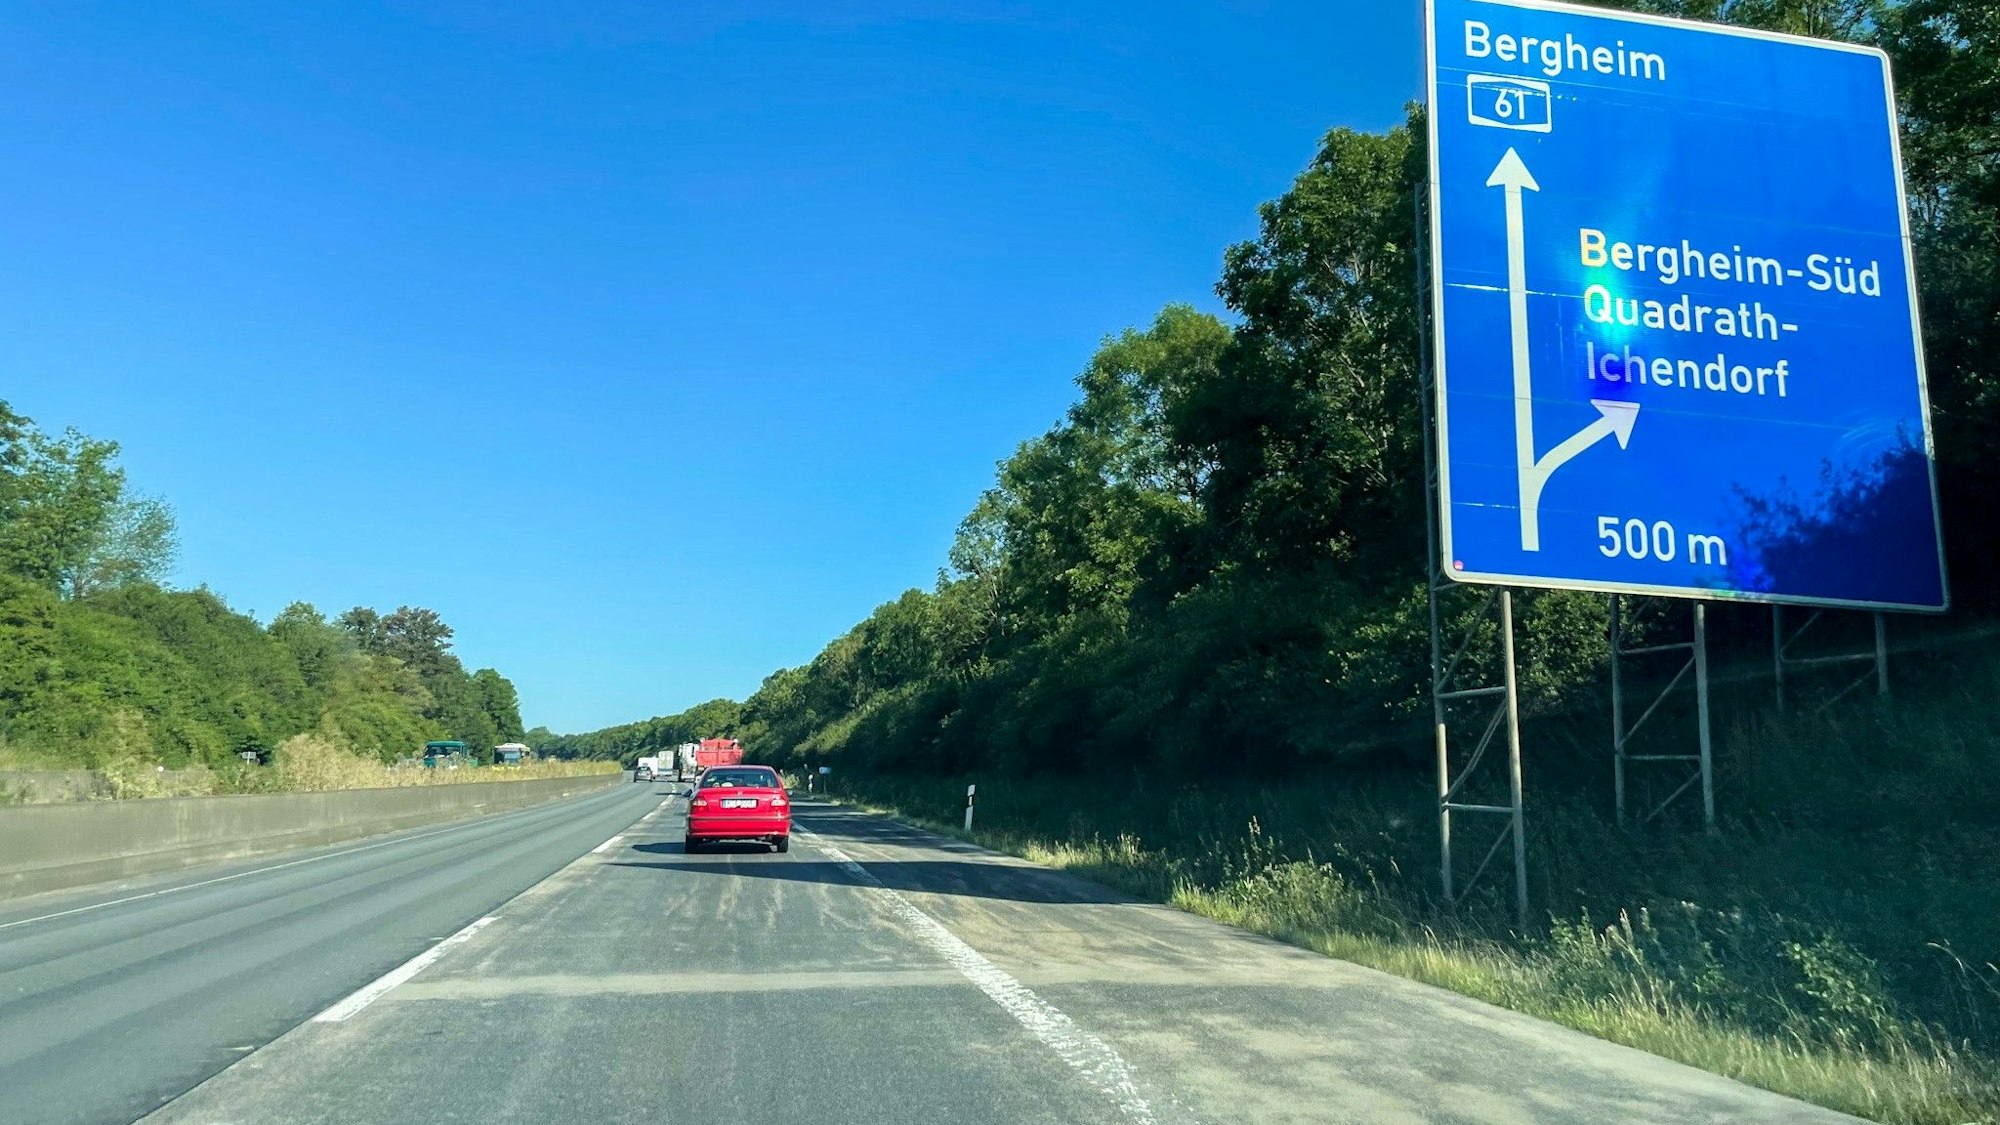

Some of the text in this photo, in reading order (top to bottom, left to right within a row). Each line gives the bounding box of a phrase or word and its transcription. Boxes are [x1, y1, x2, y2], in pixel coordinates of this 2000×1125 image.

[1465, 20, 1666, 80] Bergheim
[1494, 89, 1526, 120] 61
[1580, 228, 1881, 297] Bergheim-Süd
[1584, 285, 1798, 340] Quadrath-
[1587, 342, 1789, 397] Ichendorf
[1598, 517, 1727, 565] 500 m
